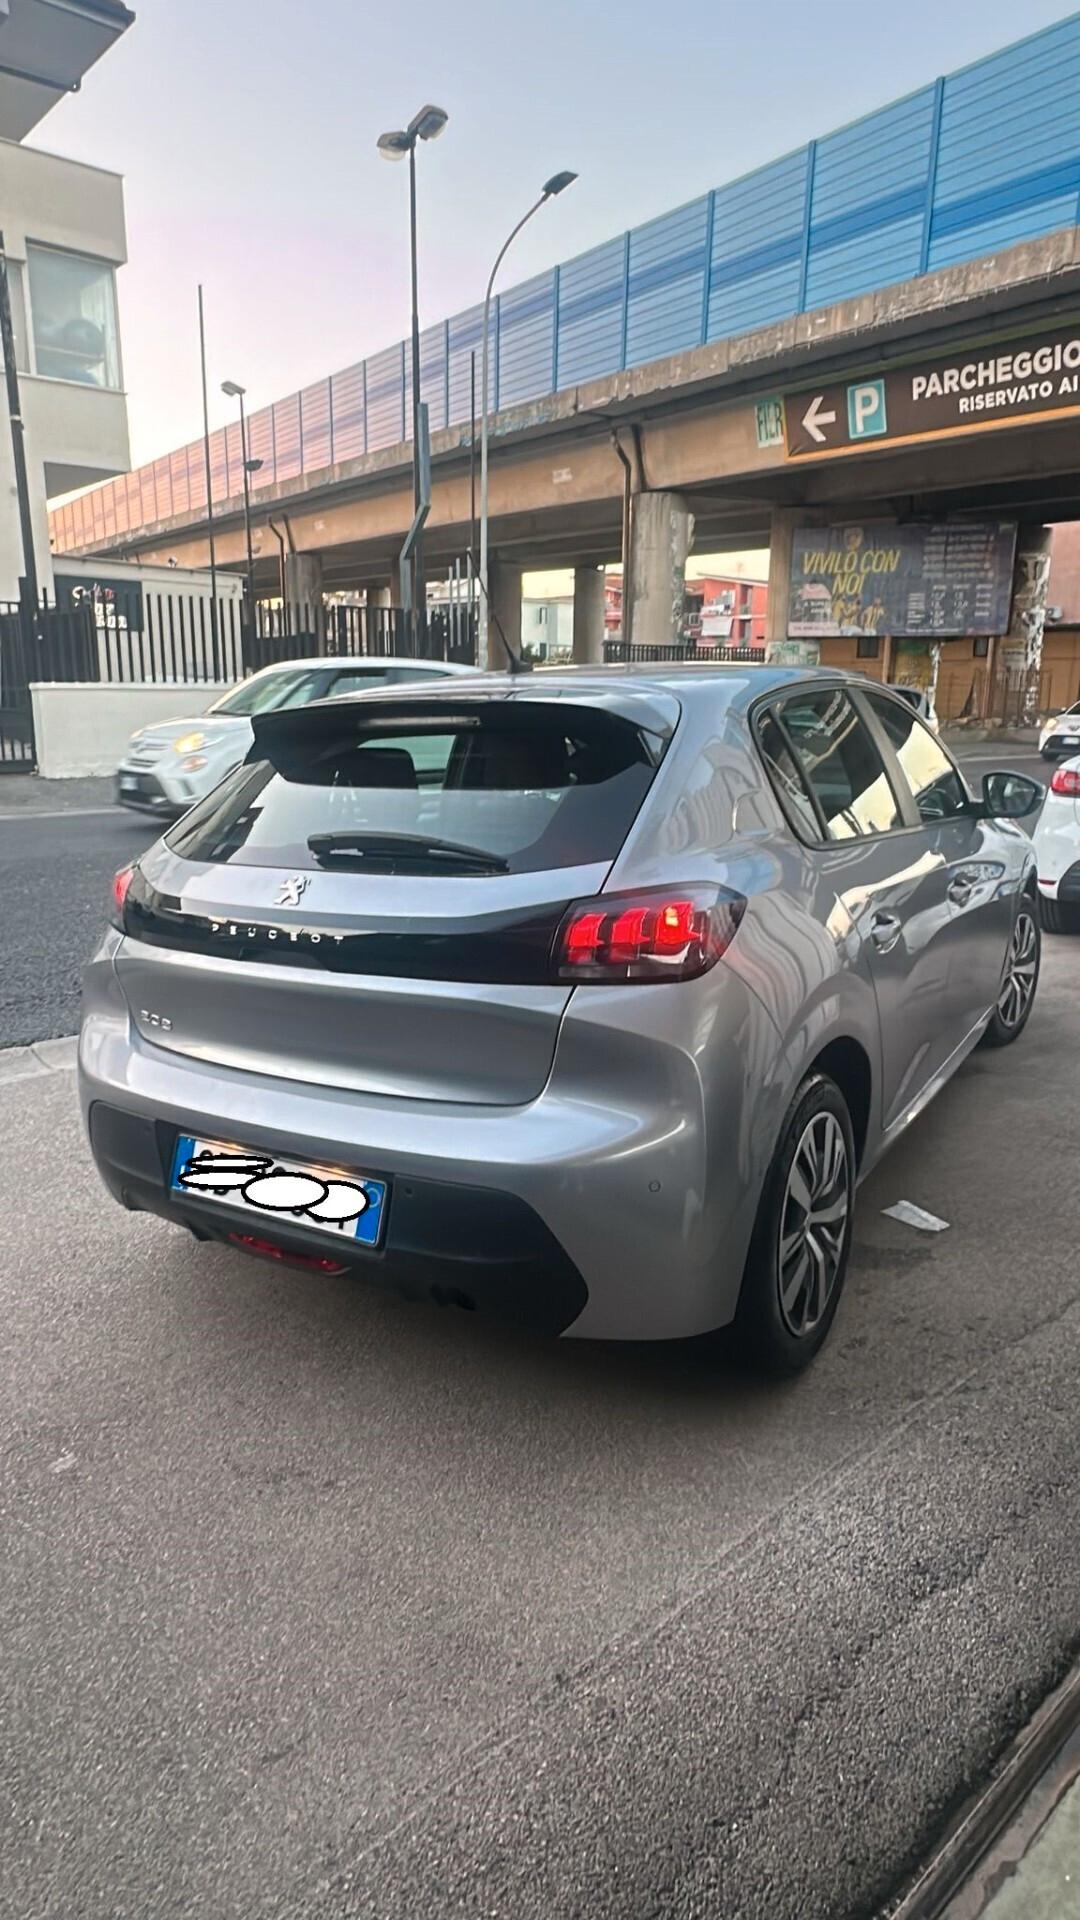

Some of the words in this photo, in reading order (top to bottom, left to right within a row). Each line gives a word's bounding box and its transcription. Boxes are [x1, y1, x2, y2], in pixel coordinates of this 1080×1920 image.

[912, 340, 1080, 400] PARCHEGGIO
[959, 380, 1053, 413] RISERVATO
[1058, 375, 1079, 394] AI
[854, 386, 880, 433] P
[802, 551, 858, 575] VIVILO
[860, 549, 901, 573] CON
[831, 574, 866, 595] NOI
[211, 923, 344, 945] PEUGEOT
[140, 1009, 173, 1031] 208
